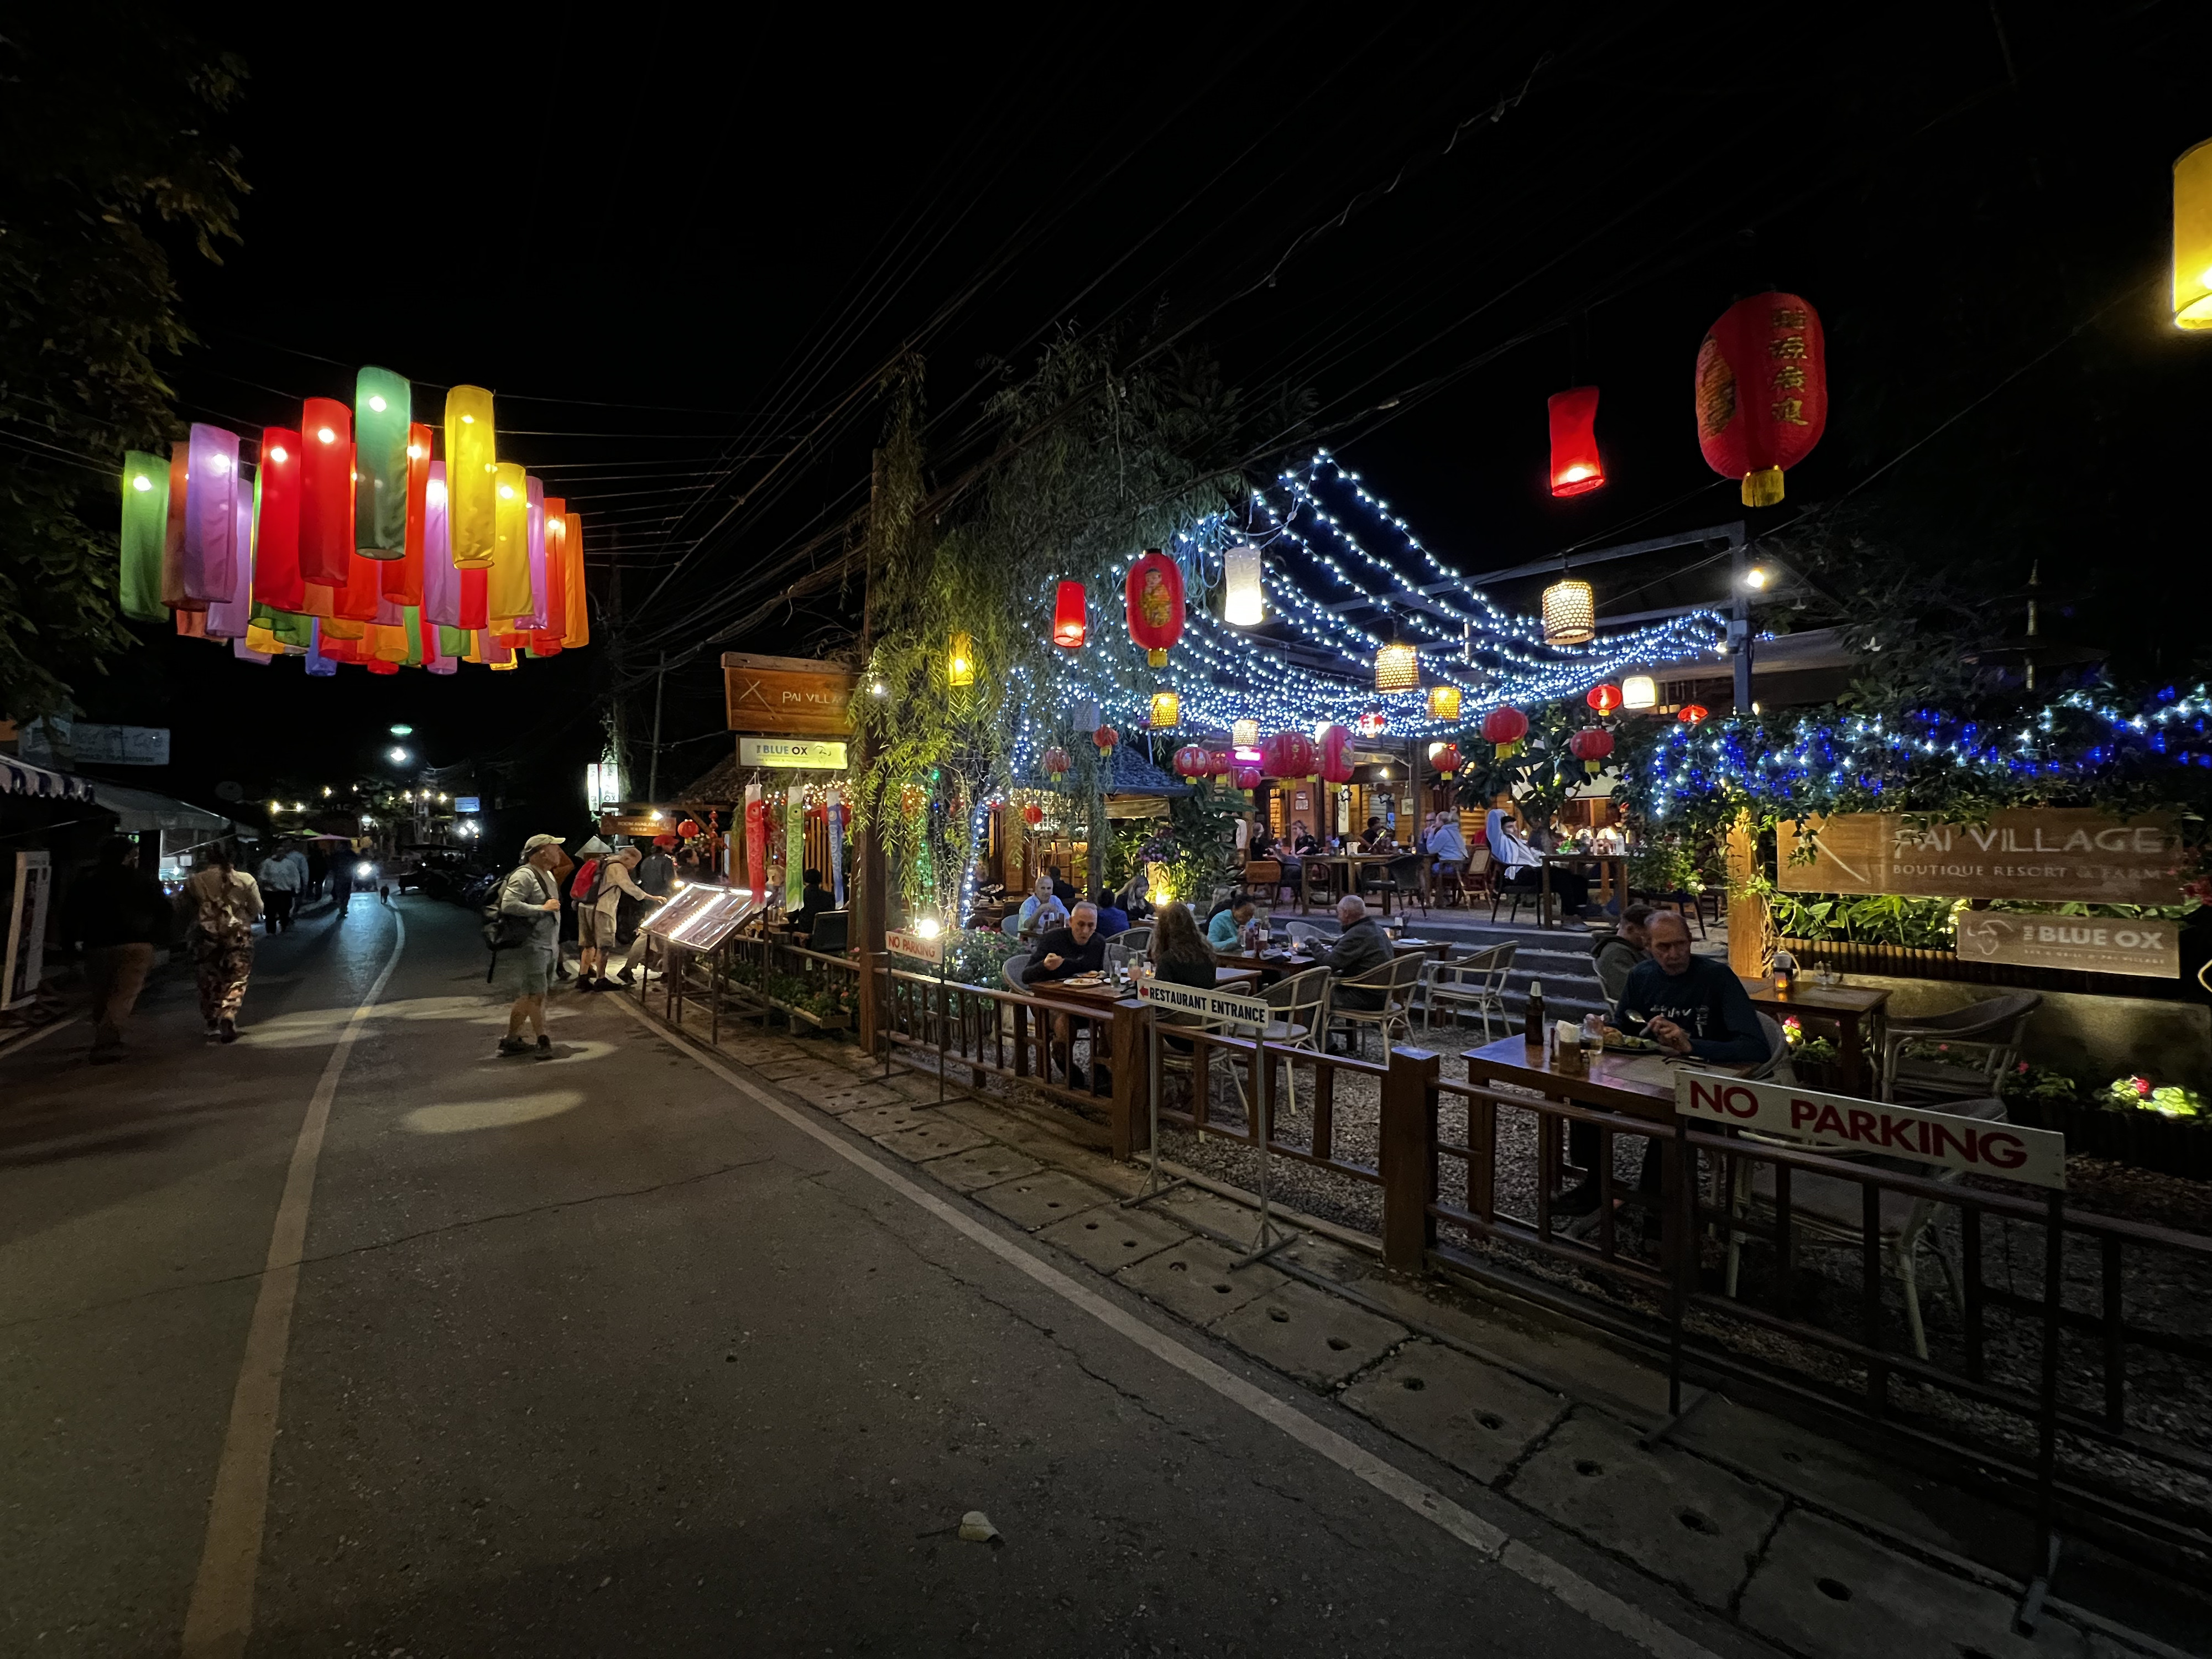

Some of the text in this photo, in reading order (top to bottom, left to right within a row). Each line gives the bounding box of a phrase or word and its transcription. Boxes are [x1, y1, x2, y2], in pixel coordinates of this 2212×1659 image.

[782, 691, 801, 703] PAI
[763, 745, 789, 754] BLUE
[792, 747, 808, 755] OX
[1892, 827, 2163, 859] PAI VILLAGE
[1893, 864, 1984, 878] BOUTIQUE
[1994, 866, 2068, 878] RESORT
[2101, 868, 2162, 880] FARM
[888, 936, 935, 958] NO PARKING
[2039, 926, 2107, 946] BLUE
[2115, 930, 2164, 950] OX
[1150, 987, 1265, 1023] RESTAURANT ENTRANCE
[1689, 1080, 2028, 1170] NO PARKING
